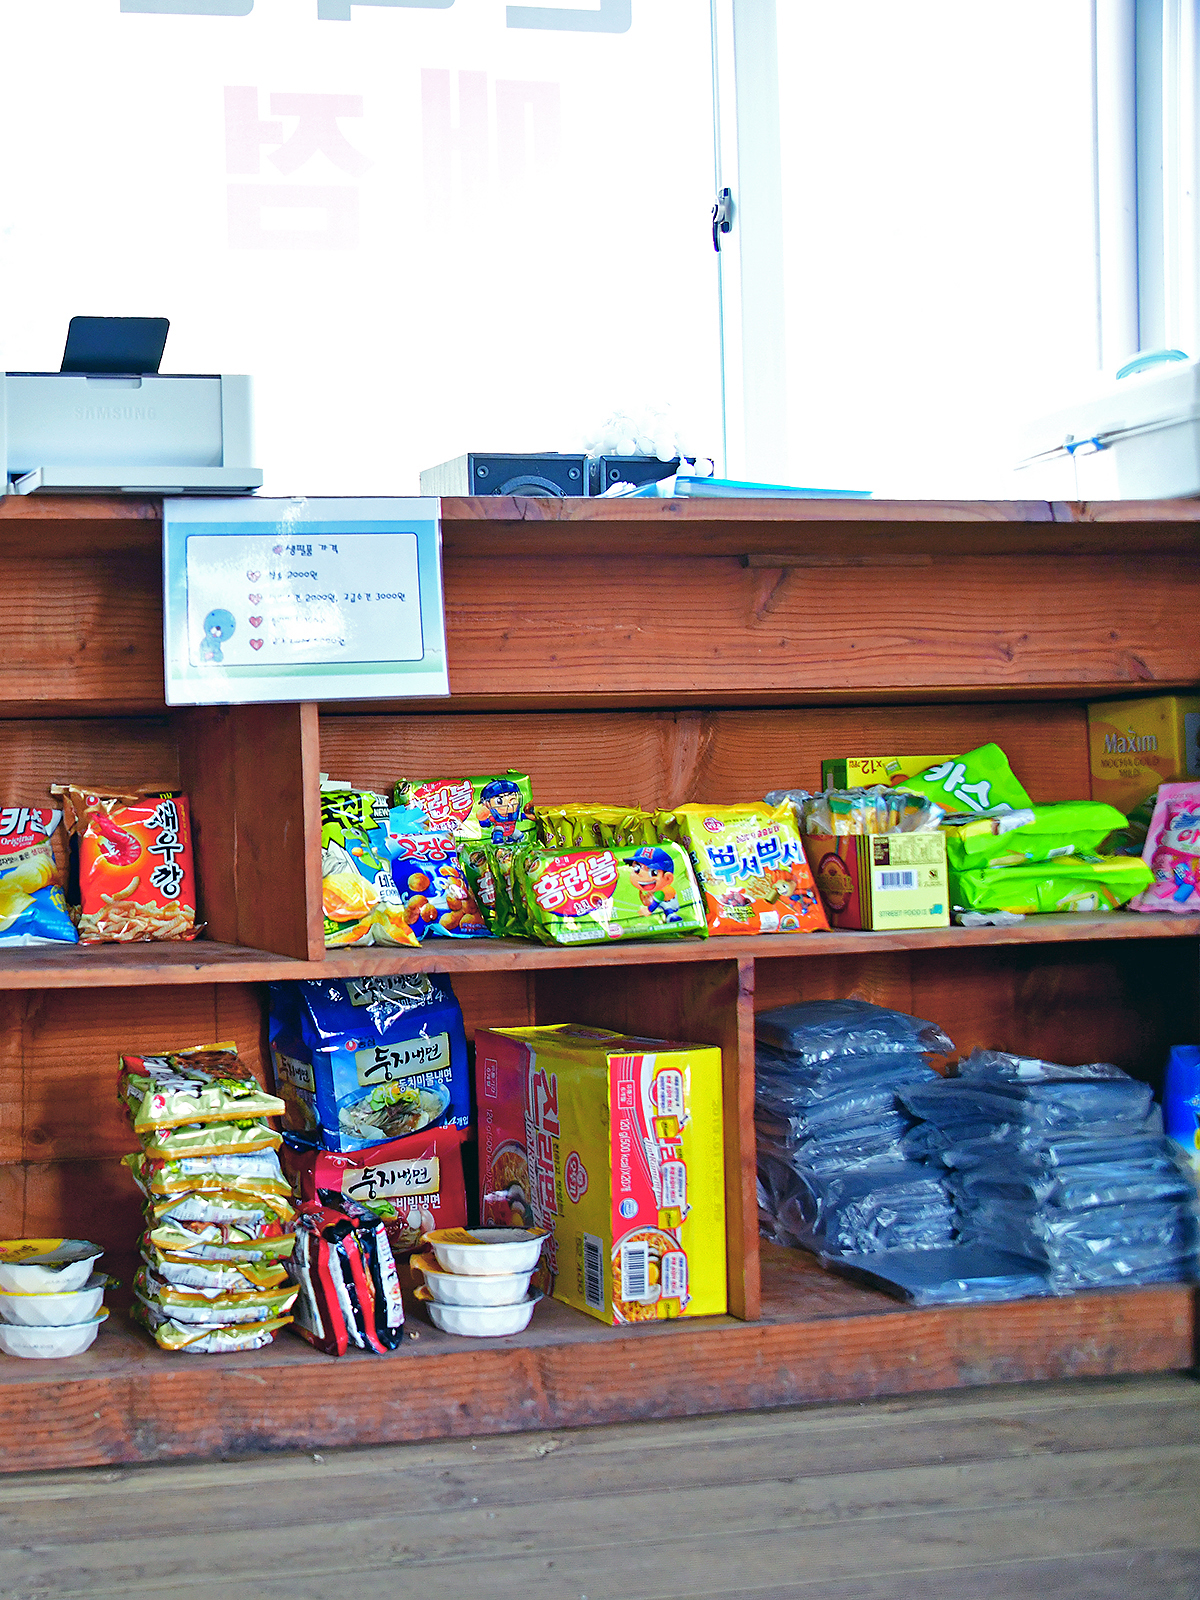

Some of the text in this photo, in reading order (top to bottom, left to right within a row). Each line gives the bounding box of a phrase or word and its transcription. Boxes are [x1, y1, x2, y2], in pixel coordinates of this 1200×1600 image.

[73, 406, 157, 420] SAMSUNG
[286, 544, 313, 556] 생필품
[375, 592, 407, 602] 3000원
[1102, 731, 1158, 754] Maxim
[373, 808, 390, 818] NEW
[0, 834, 35, 848] Original
[144, 799, 184, 898] 새우깡
[707, 836, 803, 882] 뿌셔뿌셔
[533, 851, 617, 910] 홈런볼
[364, 1044, 442, 1081] 둥지냉면
[398, 1068, 452, 1092] 동치미물냉면
[348, 1166, 432, 1199] 둥지냉면
[396, 1193, 441, 1211] 비빔냉면
